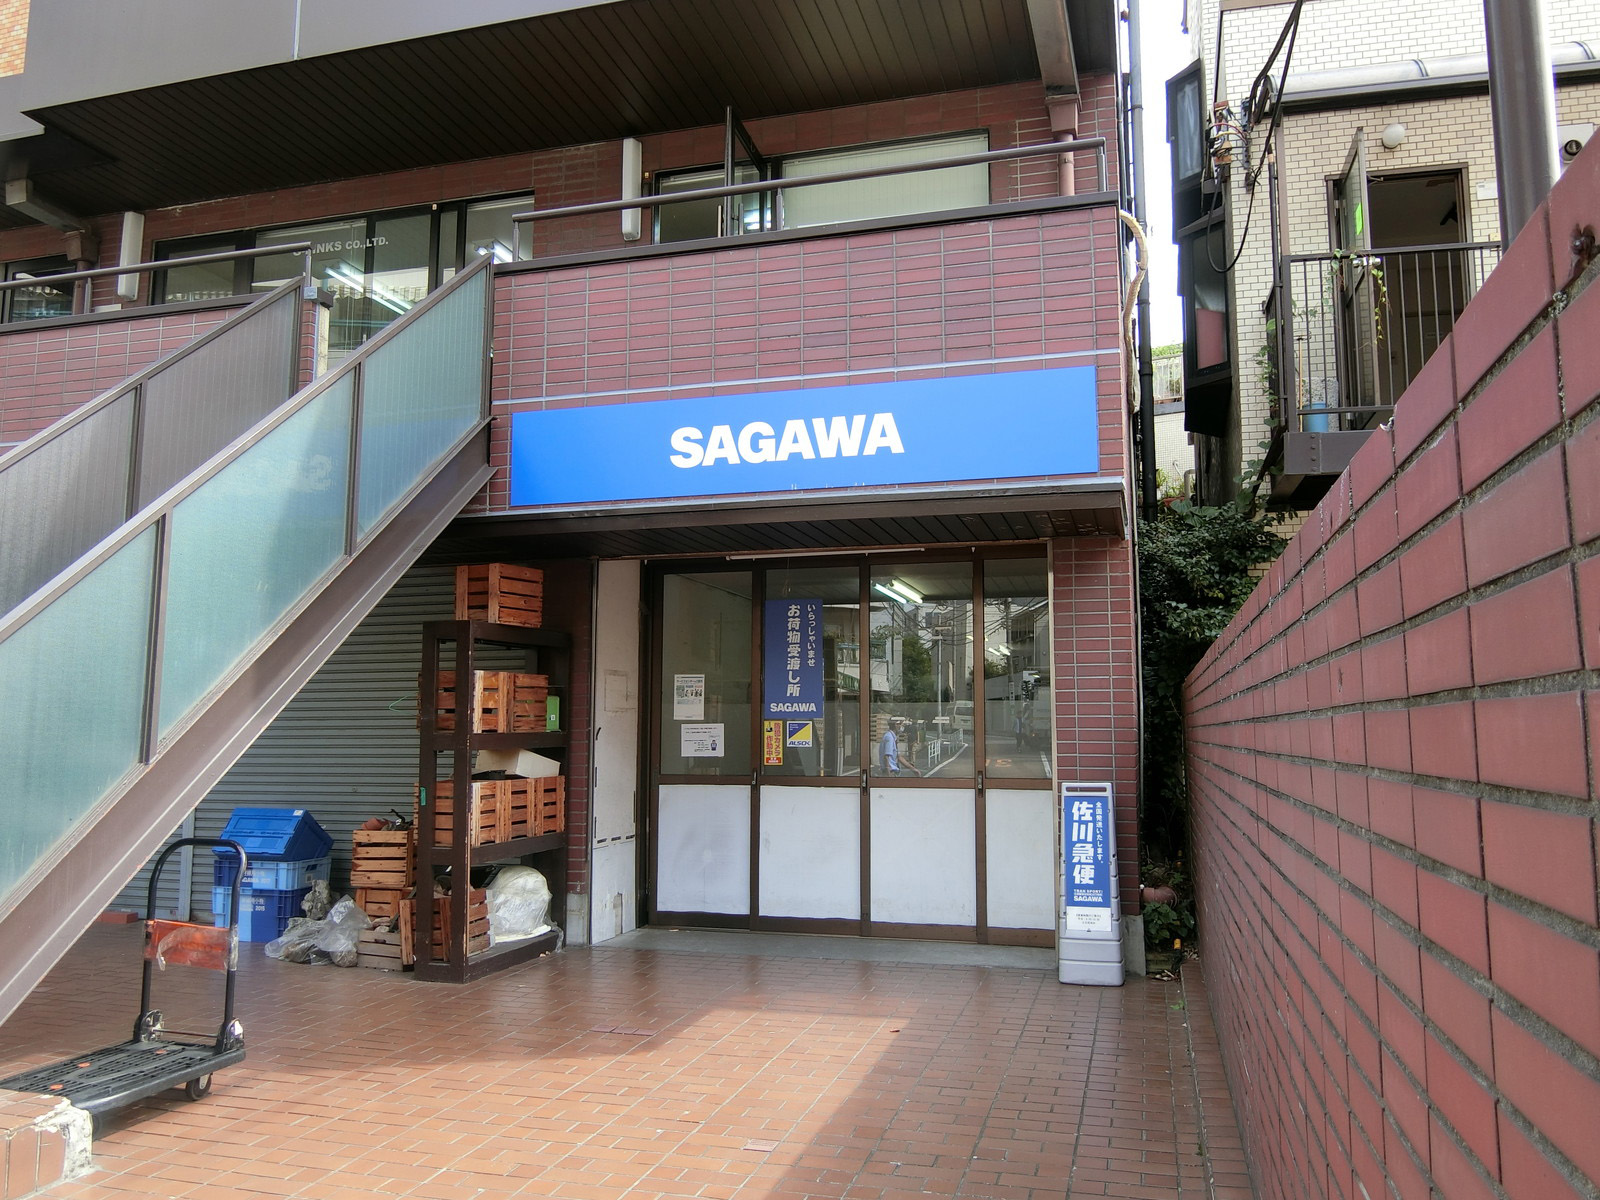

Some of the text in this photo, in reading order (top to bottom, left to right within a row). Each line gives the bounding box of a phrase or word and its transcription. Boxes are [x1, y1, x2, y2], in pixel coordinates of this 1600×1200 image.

[669, 412, 905, 469] SAGAWA
[786, 604, 801, 697] お荷物受渡し所
[807, 604, 816, 667] いらっしゃいませ
[769, 702, 817, 712] SAGAWA
[1071, 800, 1095, 885] 佐川急便
[1073, 895, 1104, 903] SAGAWA
